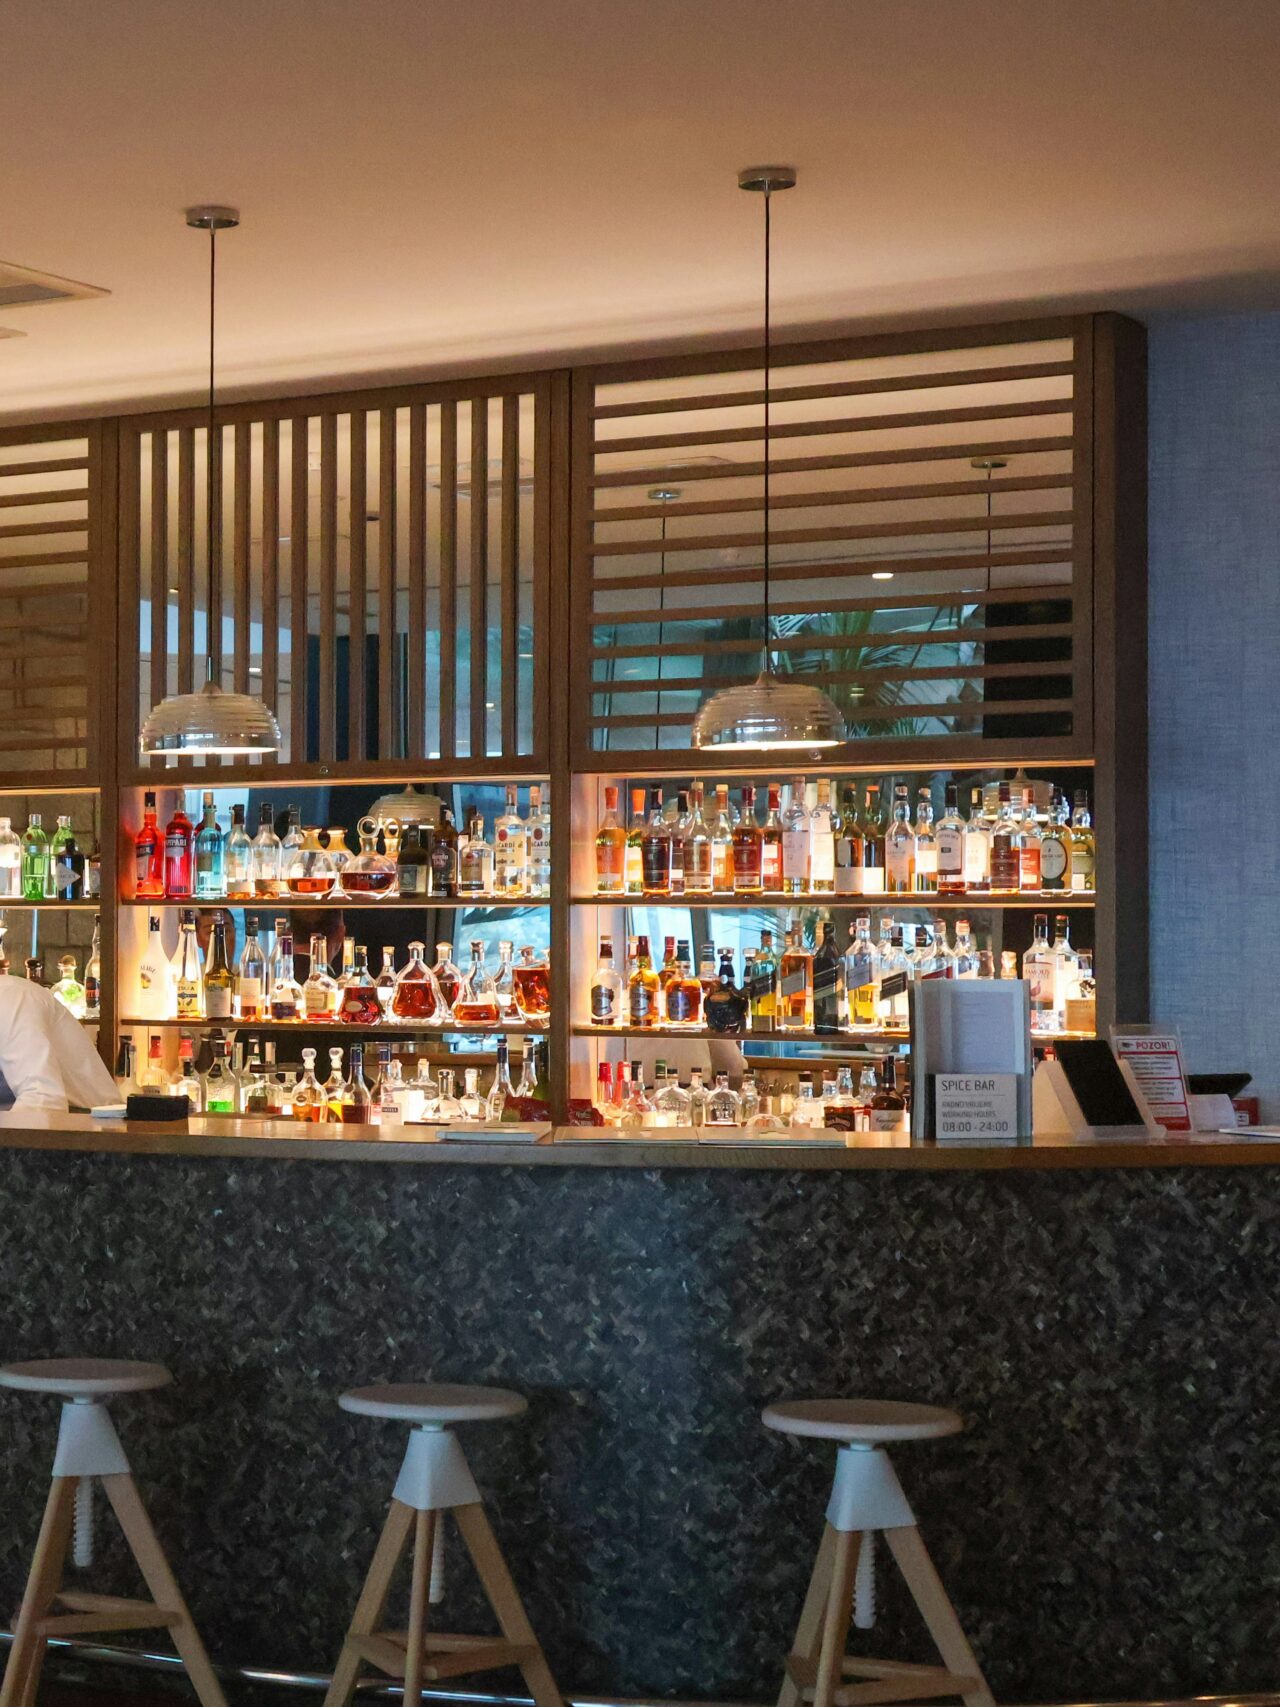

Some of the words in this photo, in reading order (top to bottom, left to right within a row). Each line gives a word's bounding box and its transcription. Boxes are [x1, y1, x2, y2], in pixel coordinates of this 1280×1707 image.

[1135, 1041, 1170, 1050] POZOR!
[941, 1080, 972, 1092] SPICE
[974, 1079, 995, 1091] BAR
[942, 1121, 972, 1133] 08:00
[978, 1121, 1009, 1132] 24:00
